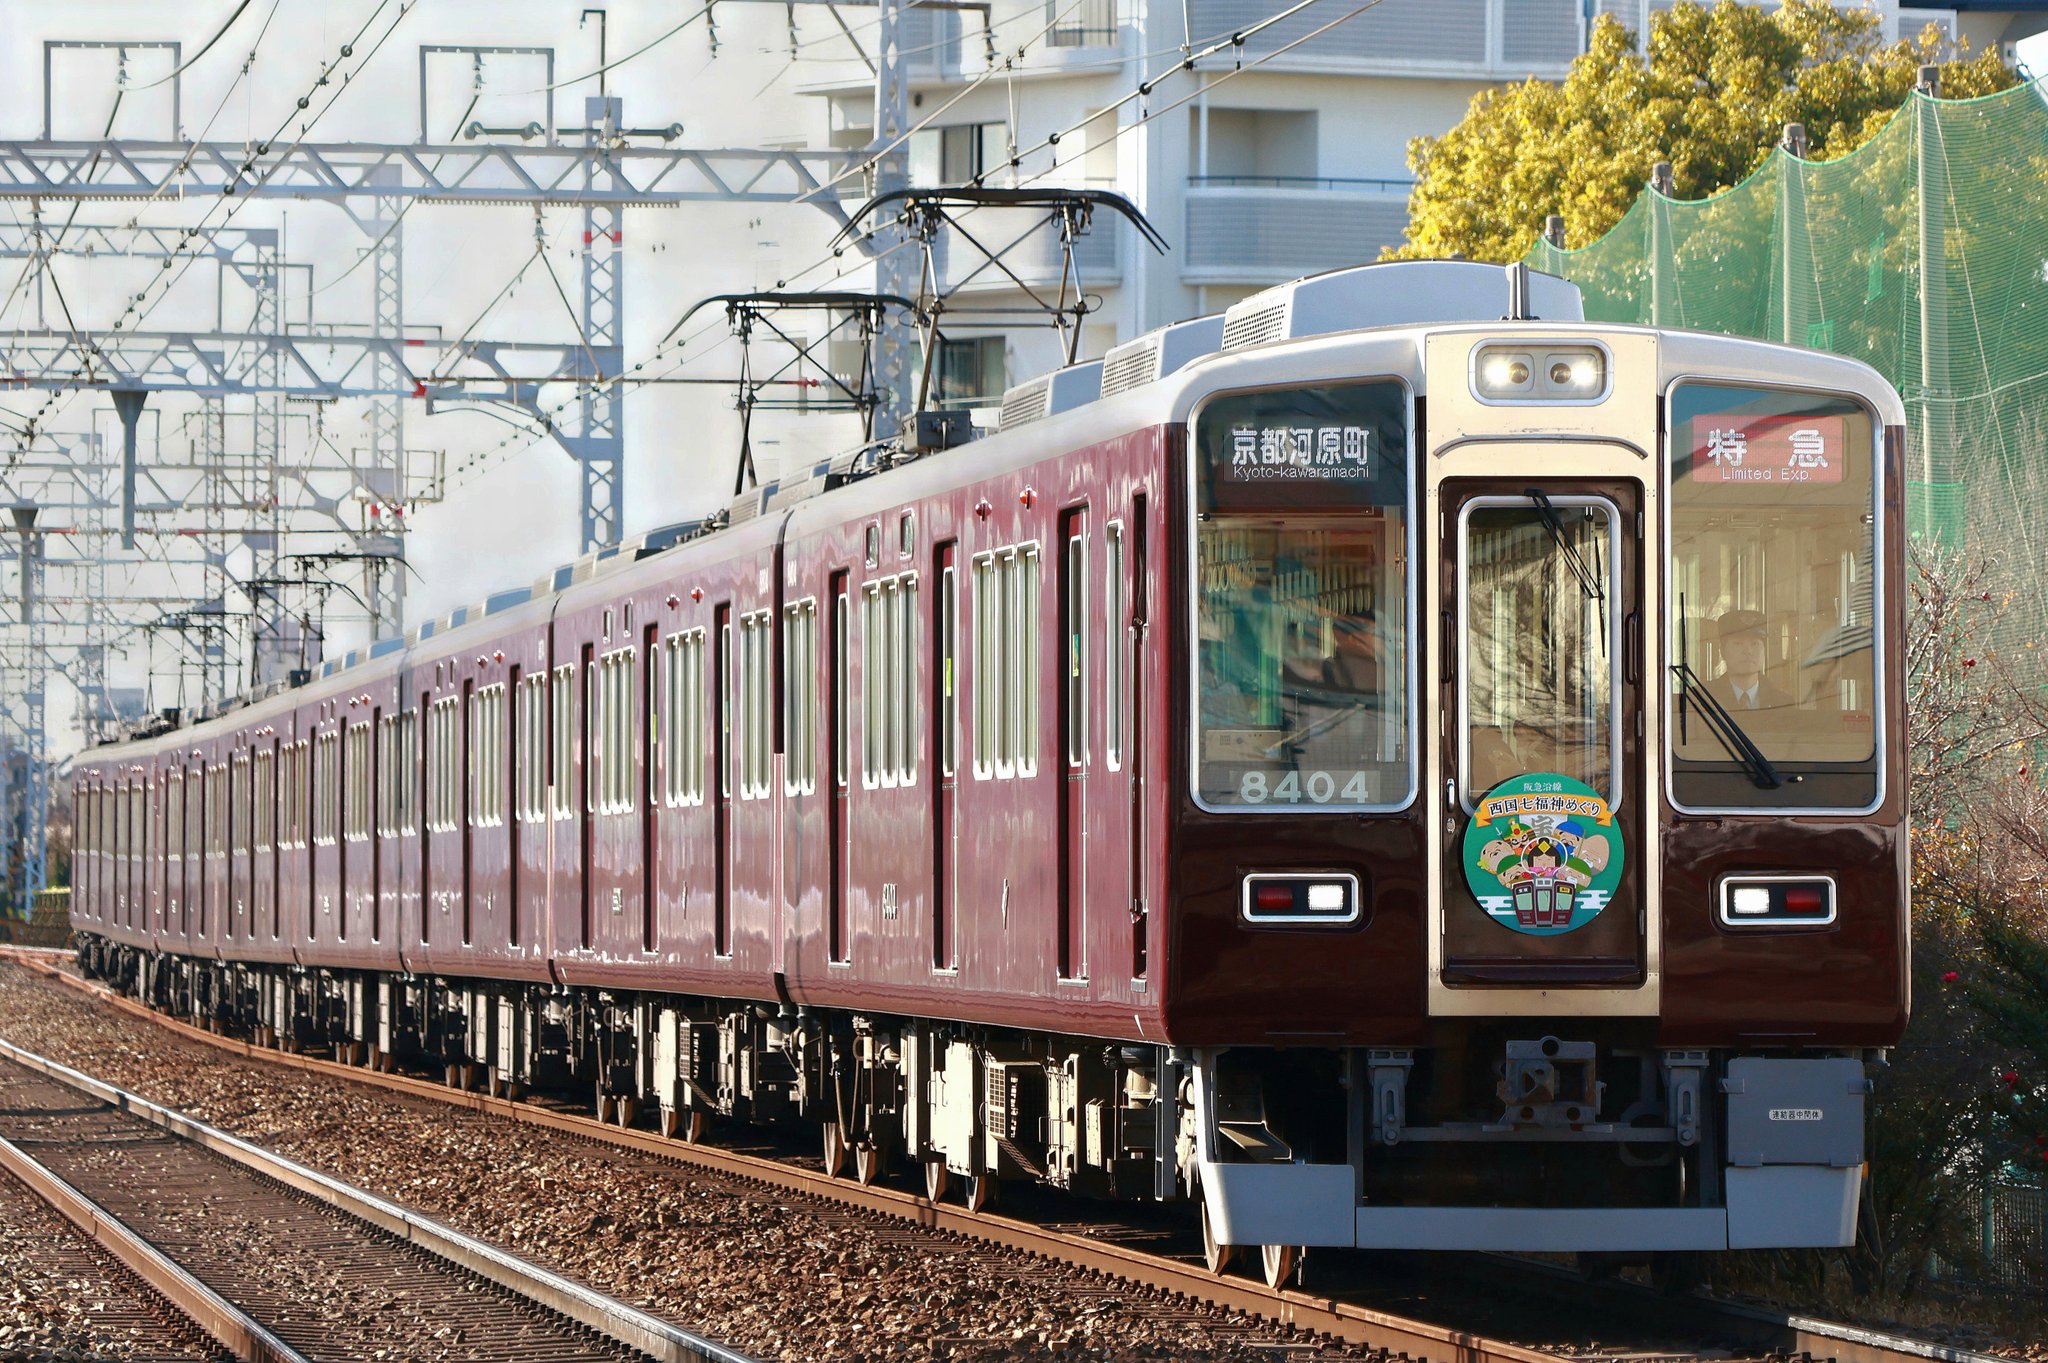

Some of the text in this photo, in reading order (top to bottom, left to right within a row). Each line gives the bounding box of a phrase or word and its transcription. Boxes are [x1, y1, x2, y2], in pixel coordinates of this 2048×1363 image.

[1232, 427, 1370, 465] 京都河原町
[1233, 465, 1370, 481] Kyoto-kawaramachi
[1722, 467, 1812, 482] Limited Exp.
[1240, 770, 1369, 804] 8404
[1523, 782, 1562, 792] 阪急沿線
[1488, 796, 1601, 816] 西国七福神めぐり
